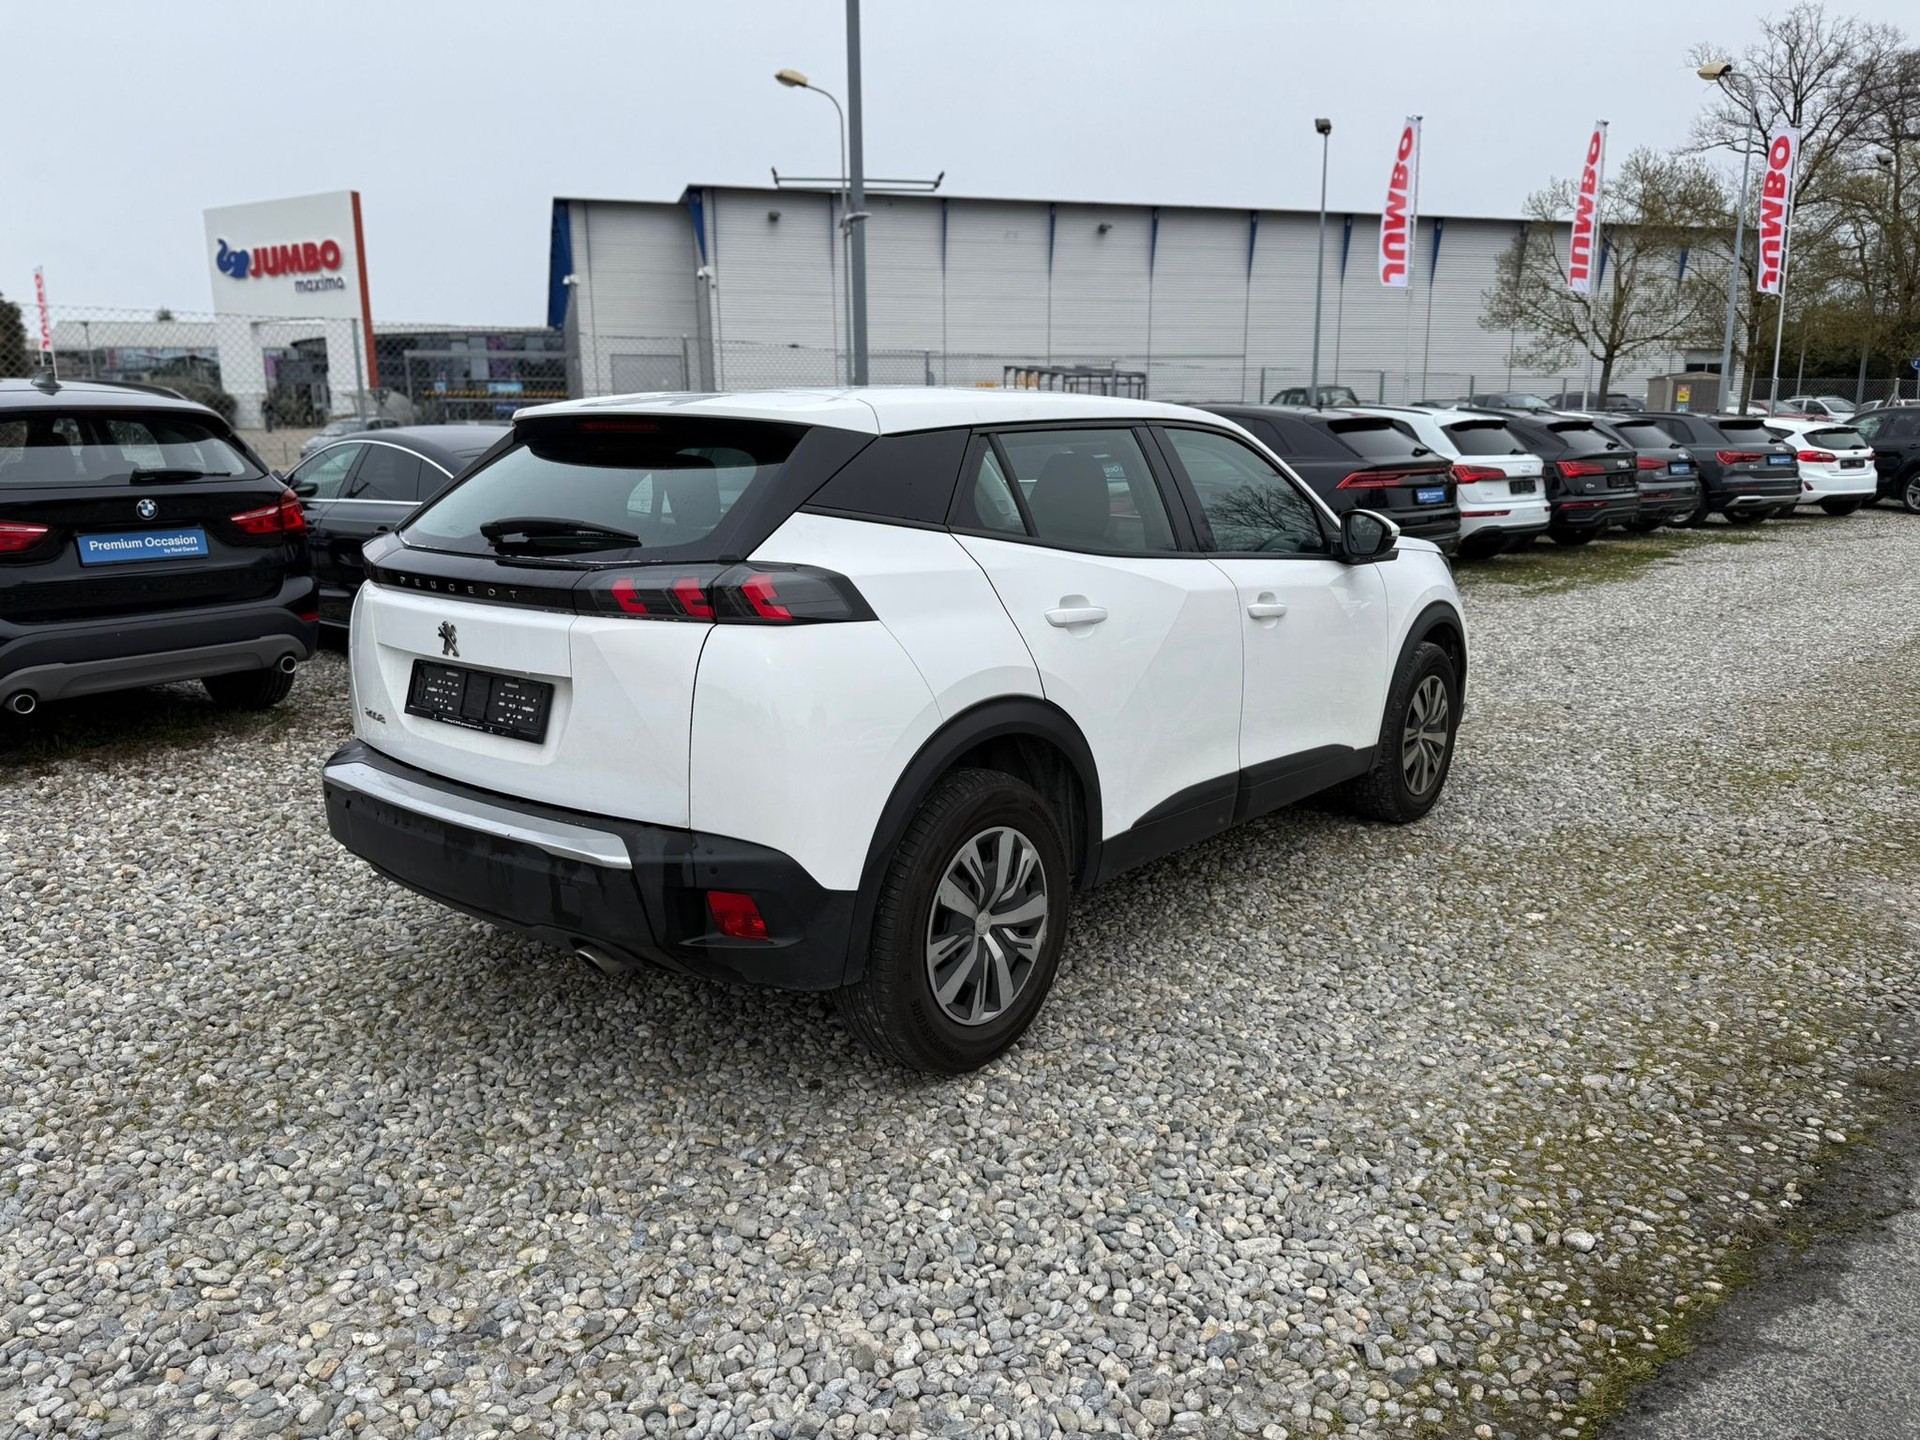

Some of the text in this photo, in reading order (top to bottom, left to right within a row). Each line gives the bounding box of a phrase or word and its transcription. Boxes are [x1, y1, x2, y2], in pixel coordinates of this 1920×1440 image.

[1382, 126, 1413, 284] JUMBO
[1569, 131, 1601, 287] JUMBO
[1761, 135, 1791, 289] JUMBO
[251, 239, 341, 278] JUMBO
[295, 274, 345, 292] maxima
[89, 535, 198, 551] Premium Occasion
[400, 576, 517, 599] PEUGEOT
